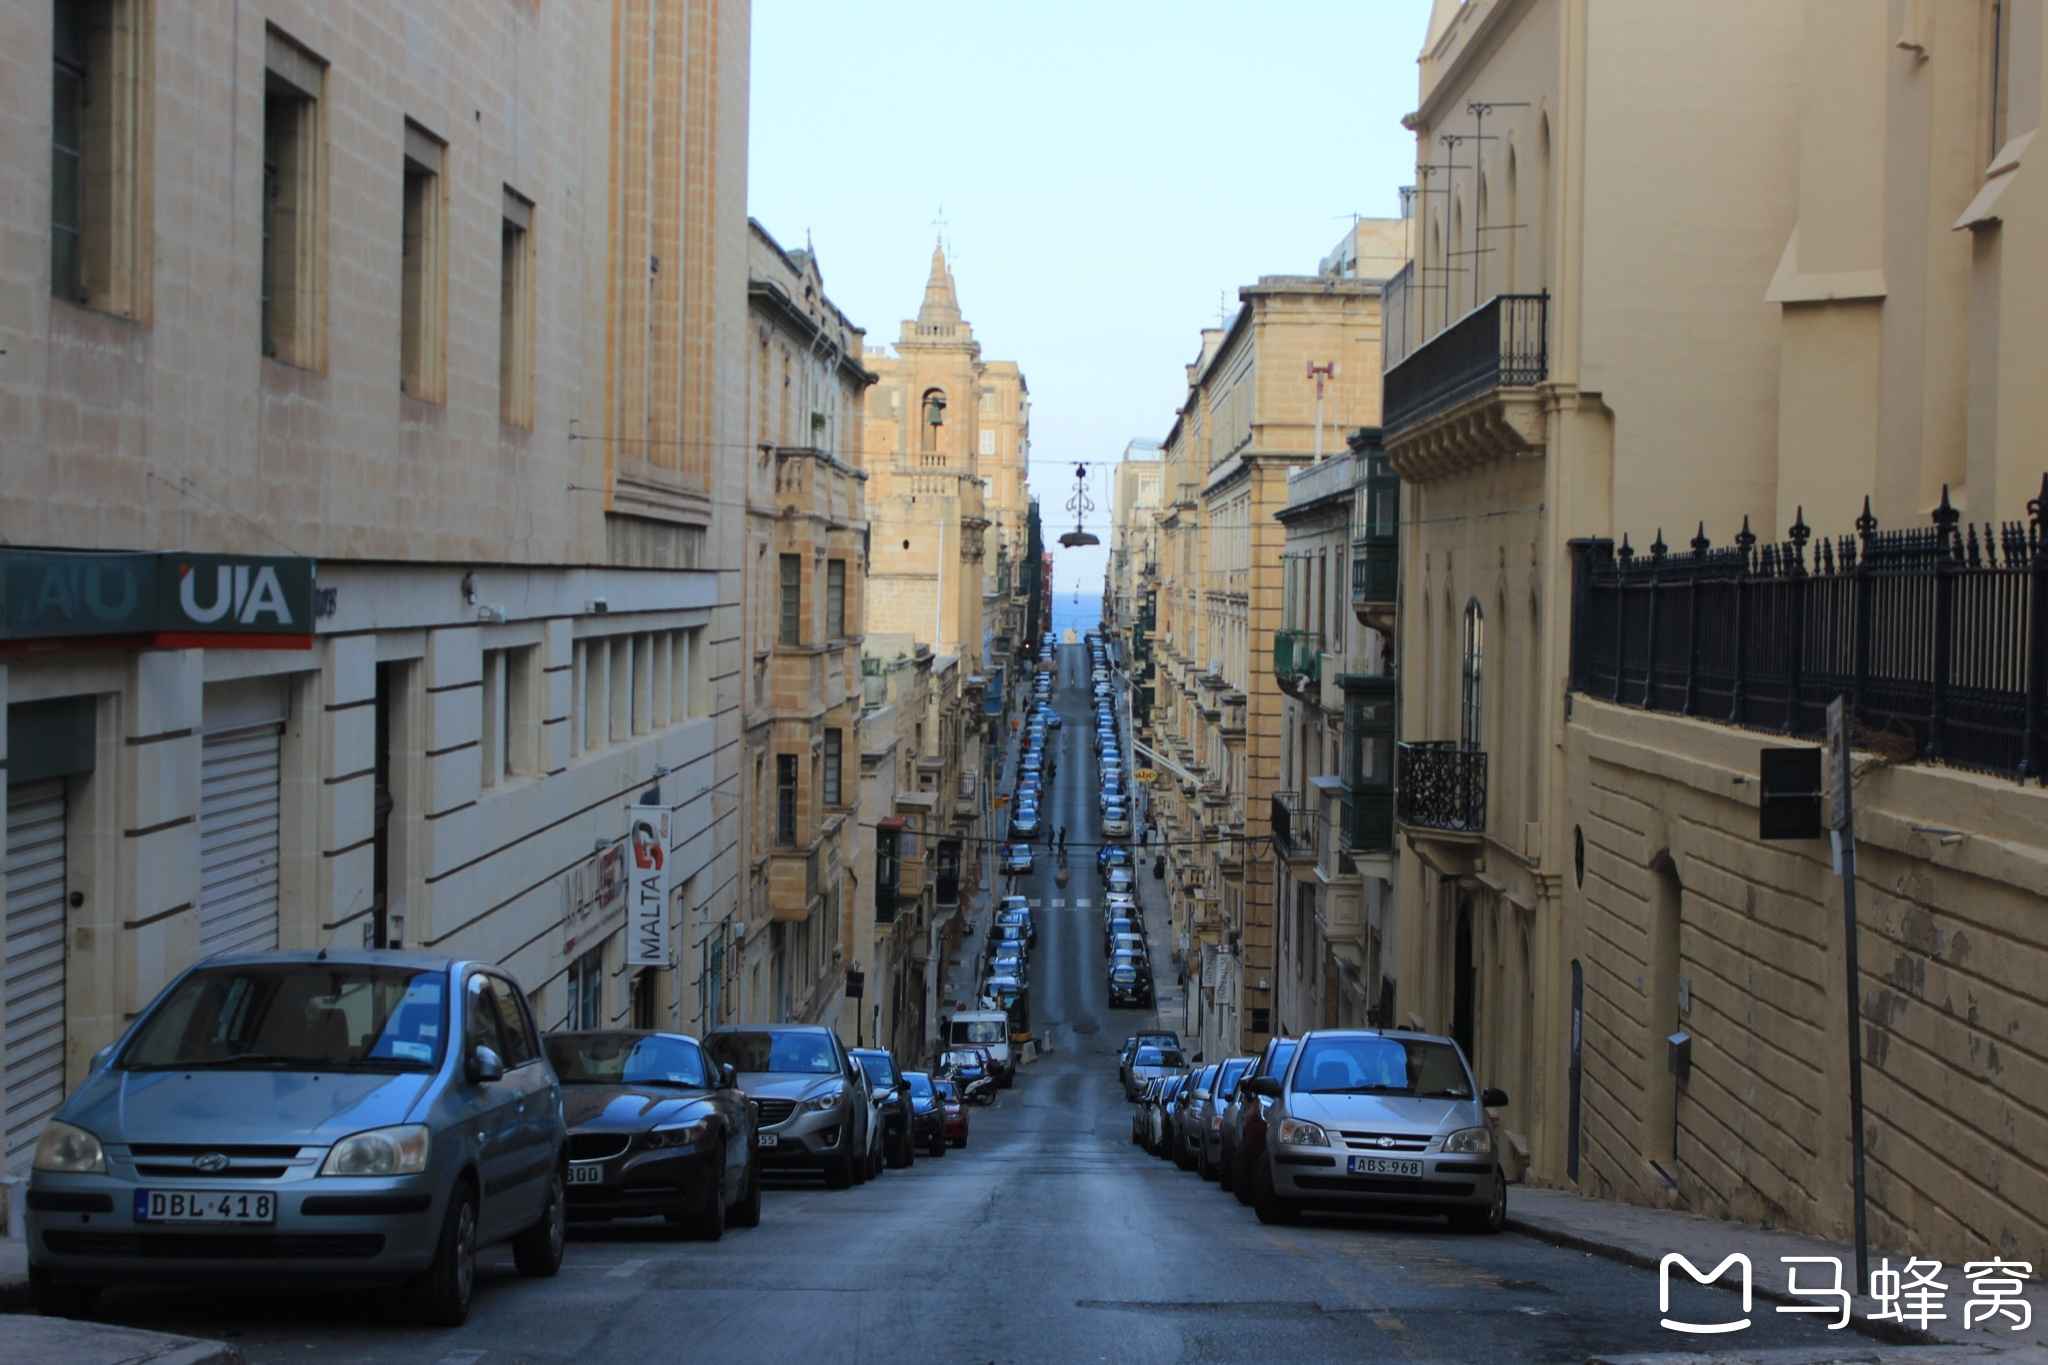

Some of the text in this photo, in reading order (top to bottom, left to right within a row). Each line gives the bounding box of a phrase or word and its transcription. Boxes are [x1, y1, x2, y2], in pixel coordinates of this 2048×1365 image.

[640, 875, 661, 960] MALTA
[1358, 1159, 1418, 1175] ABS 968
[152, 1194, 270, 1218] DBL 418
